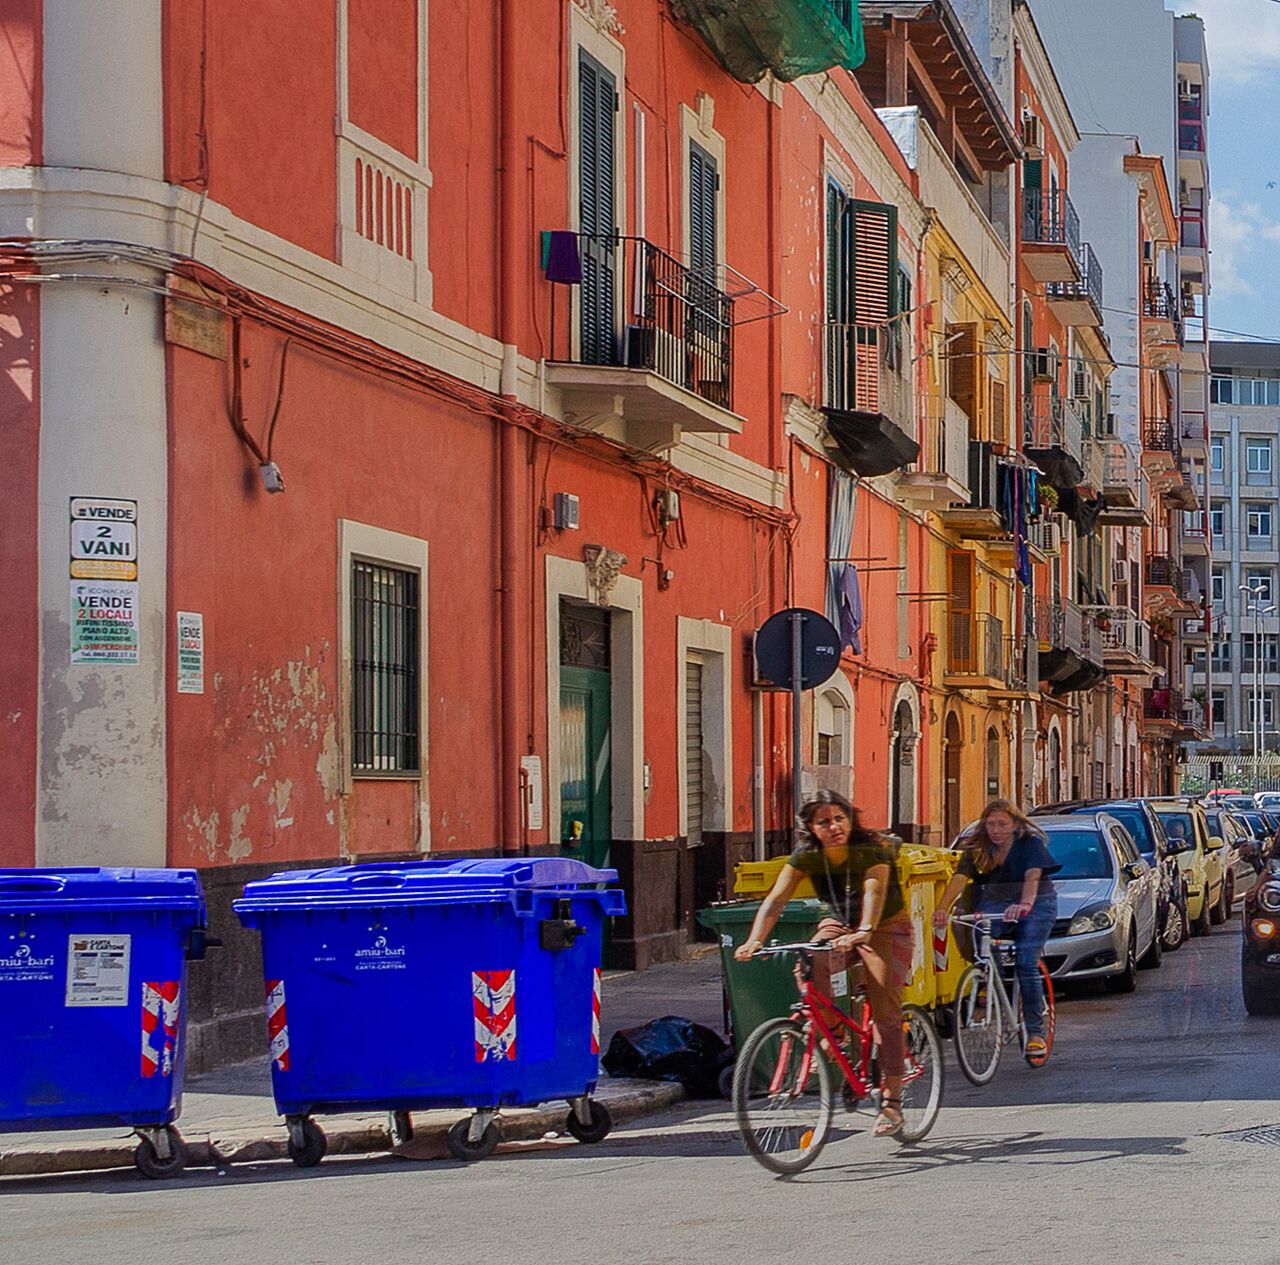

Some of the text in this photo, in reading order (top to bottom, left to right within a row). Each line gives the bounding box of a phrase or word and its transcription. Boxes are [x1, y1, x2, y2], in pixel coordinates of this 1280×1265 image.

[88, 506, 134, 520] VENDE
[96, 526, 112, 538] 2
[80, 540, 130, 556] VANI
[78, 596, 132, 609] VENDE
[78, 609, 132, 620] 2 LOCALI
